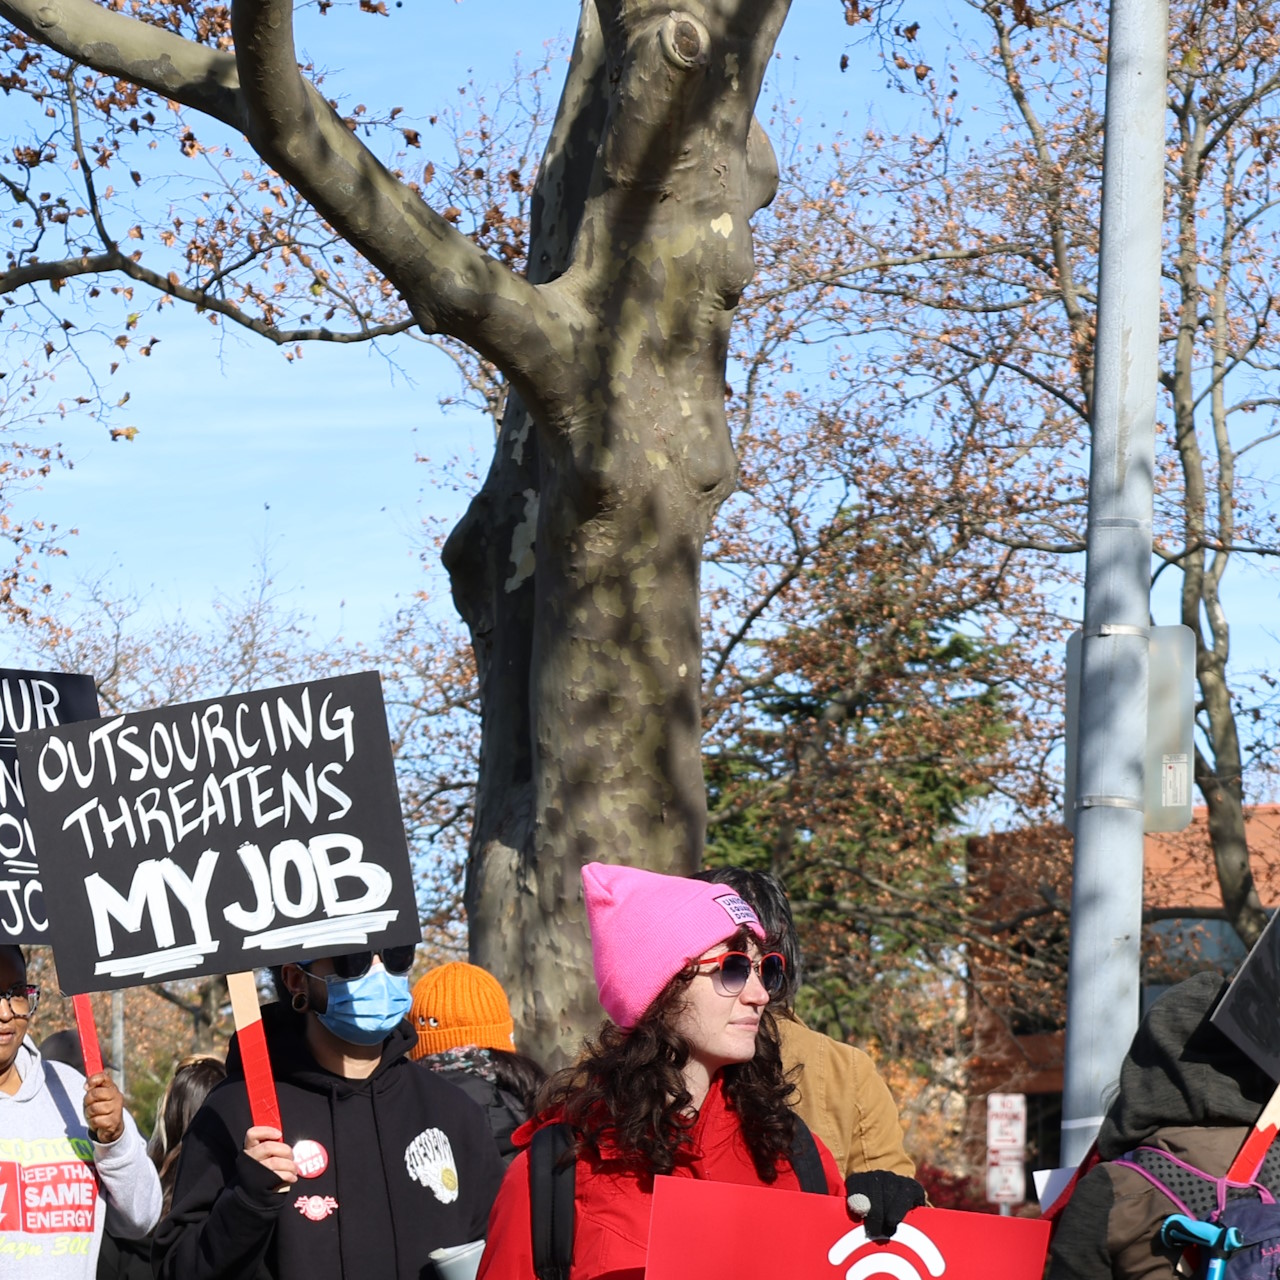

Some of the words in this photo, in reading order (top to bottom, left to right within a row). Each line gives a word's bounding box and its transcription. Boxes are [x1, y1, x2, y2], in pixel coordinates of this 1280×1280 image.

[37, 686, 355, 793] OUTSOURCING
[61, 762, 353, 859] THREATENS
[83, 848, 220, 957] MY
[223, 833, 393, 932] JOB
[24, 1183, 93, 1207] SAME
[26, 1209, 93, 1229] ENERGY
[60, 1163, 96, 1180] THA
